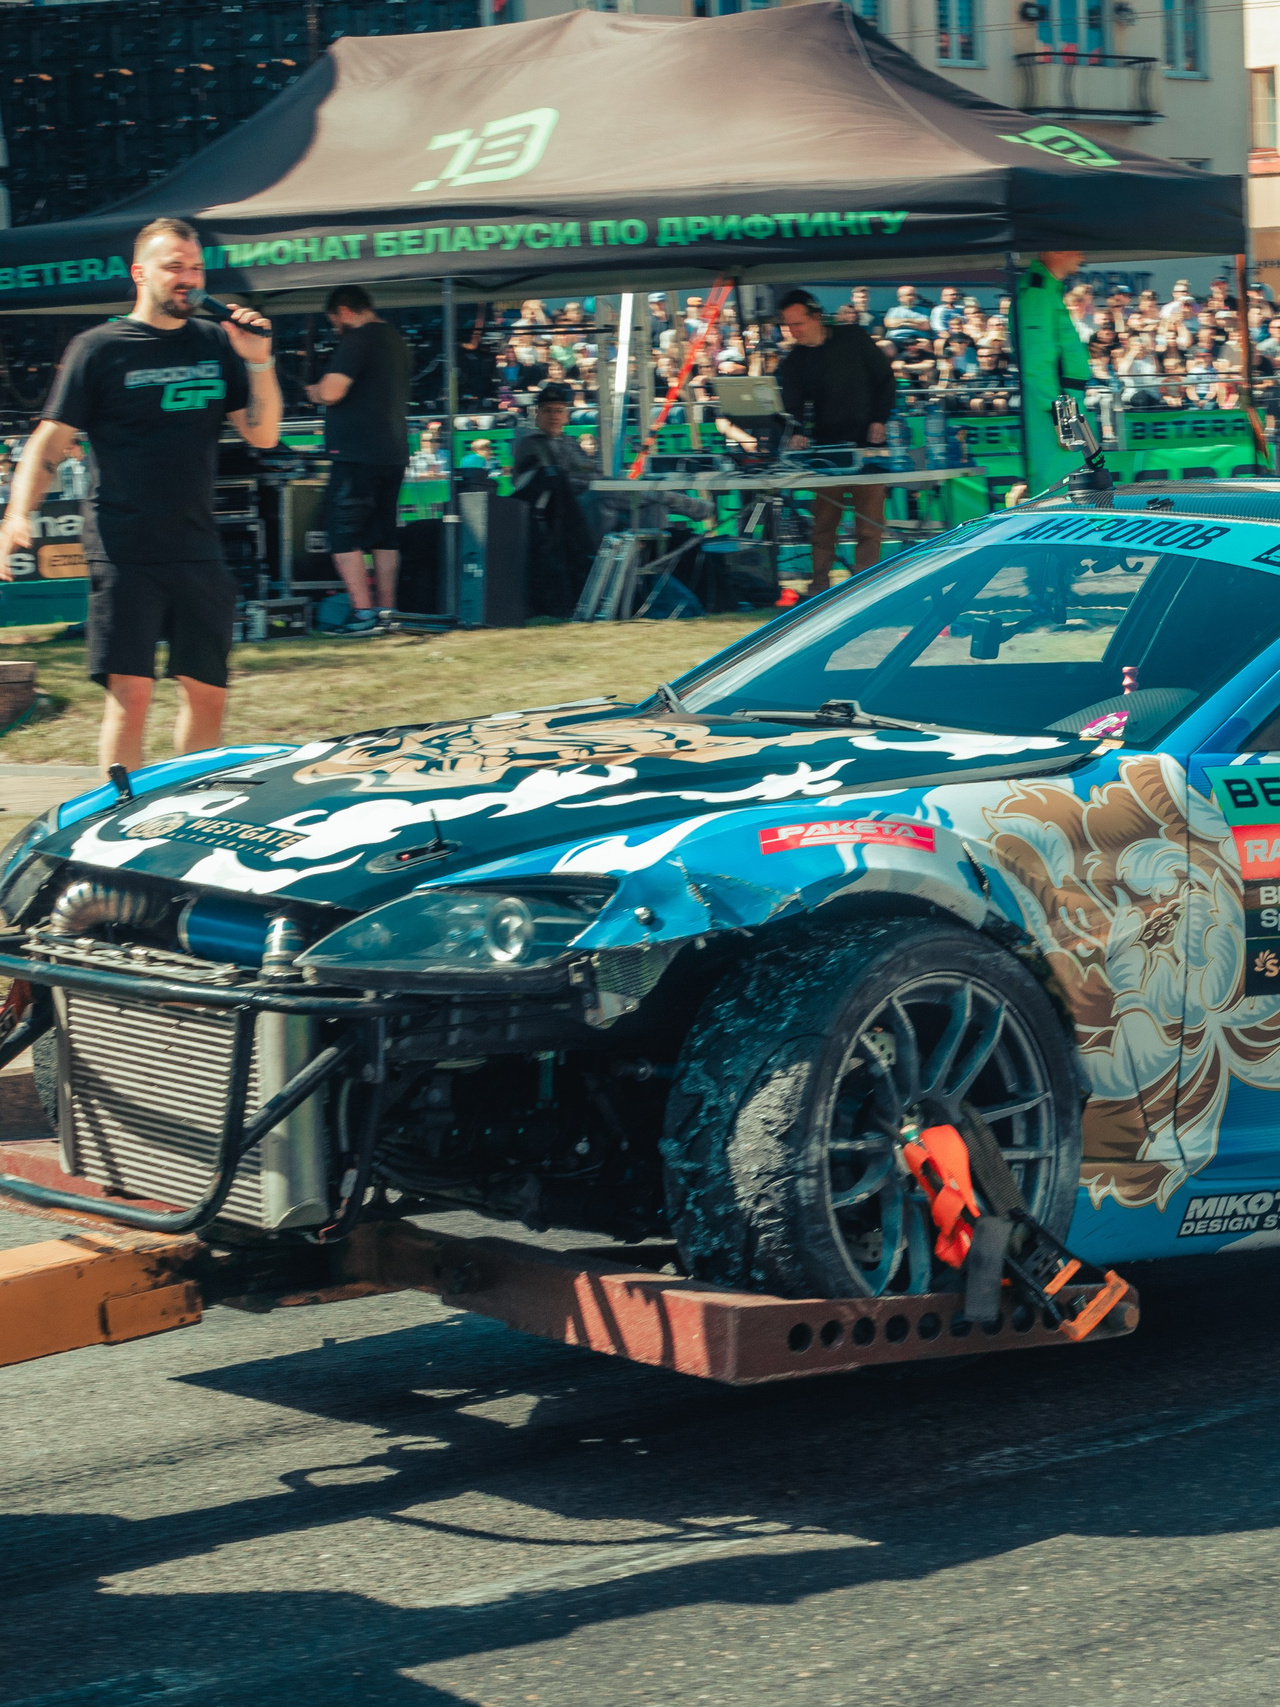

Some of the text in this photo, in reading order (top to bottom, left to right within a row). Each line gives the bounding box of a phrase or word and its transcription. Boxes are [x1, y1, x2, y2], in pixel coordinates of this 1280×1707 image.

[0, 210, 909, 290] BETERA ПИОНАТ БЕЛАРУСИ ПО ДРИФТИНГУ
[161, 379, 227, 411] GP
[1006, 517, 1231, 551] АНТРОПОВ
[186, 818, 307, 848] WESTGATE
[1179, 1216, 1260, 1237] DESIGN
